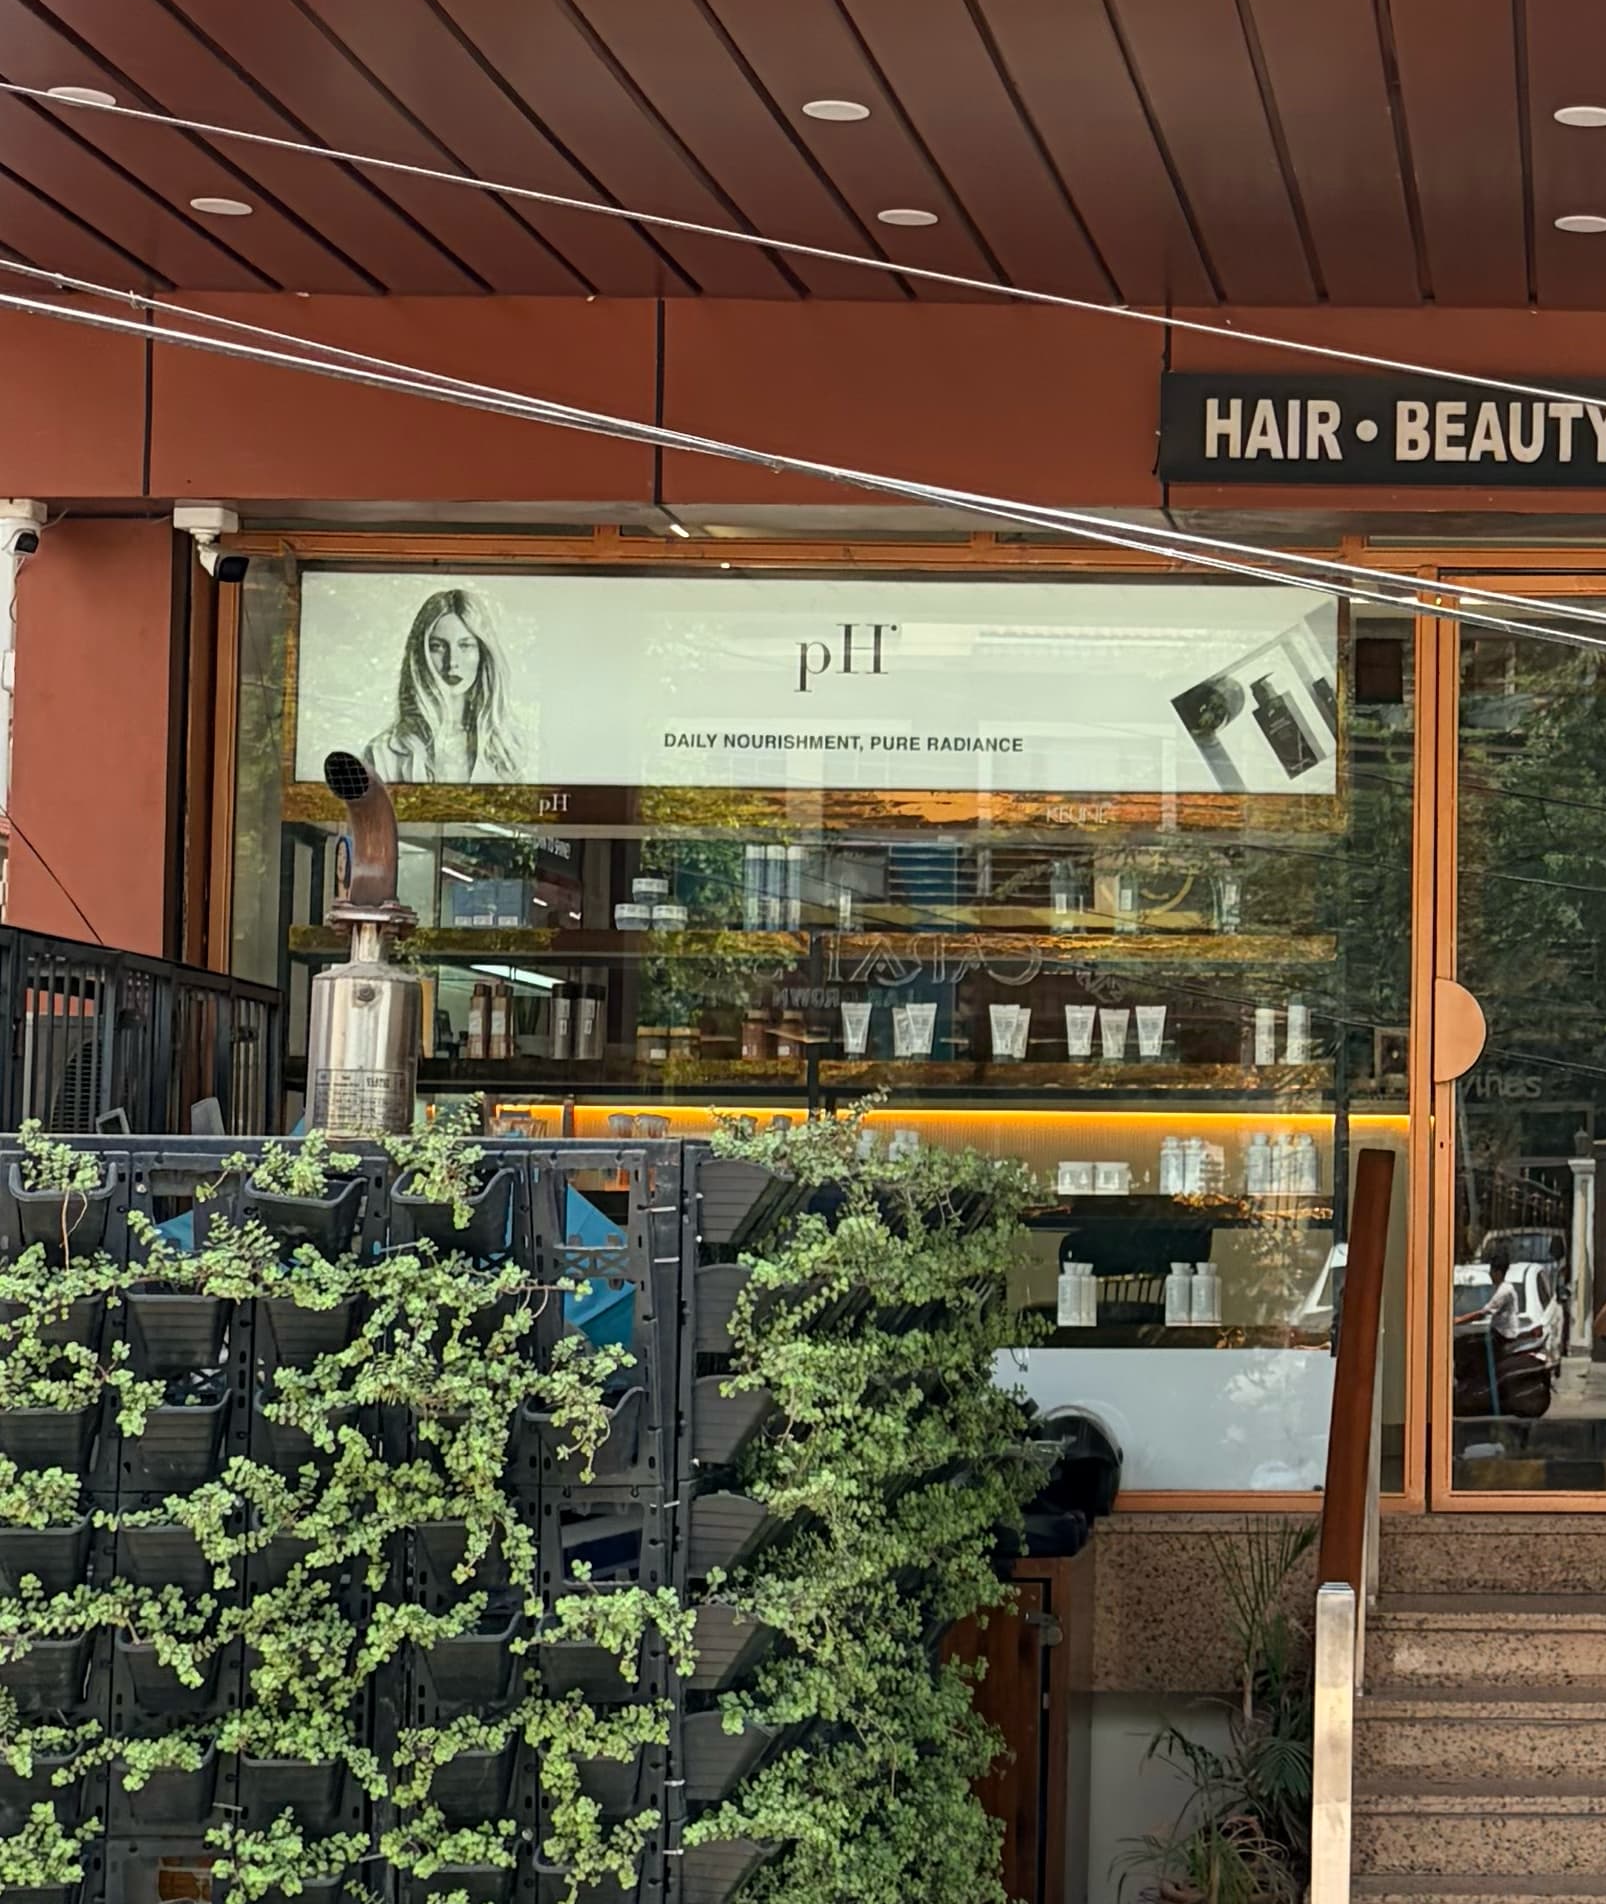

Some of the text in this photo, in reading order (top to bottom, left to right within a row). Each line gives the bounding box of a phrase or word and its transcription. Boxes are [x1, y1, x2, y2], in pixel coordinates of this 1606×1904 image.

[1204, 398, 1342, 462] HAIR
[793, 622, 890, 694] pH
[664, 732, 1024, 753] DAILY NOURISHMENT, PURE RADIANCE
[538, 793, 568, 817] pH
